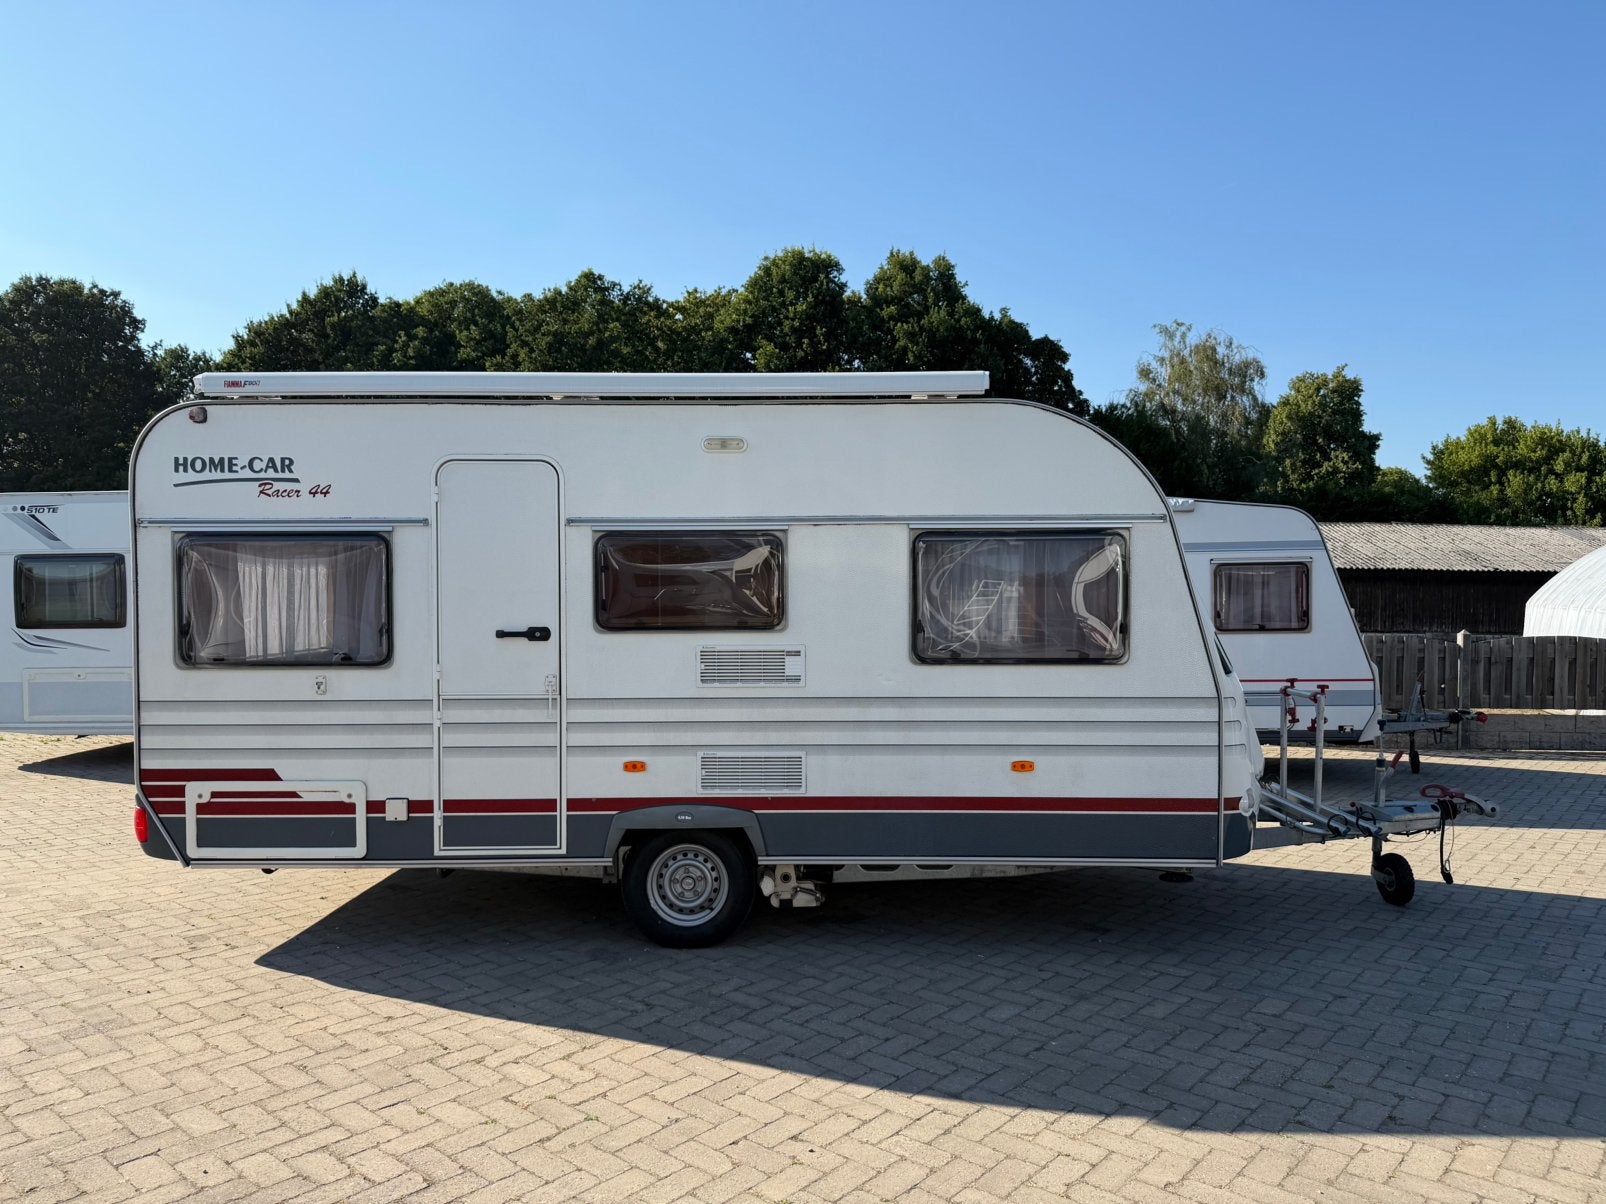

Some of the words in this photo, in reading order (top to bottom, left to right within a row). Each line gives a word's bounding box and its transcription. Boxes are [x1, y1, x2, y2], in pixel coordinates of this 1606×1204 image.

[173, 456, 295, 474] HOME-CAR
[257, 482, 302, 498] Racer
[308, 484, 332, 498] 44
